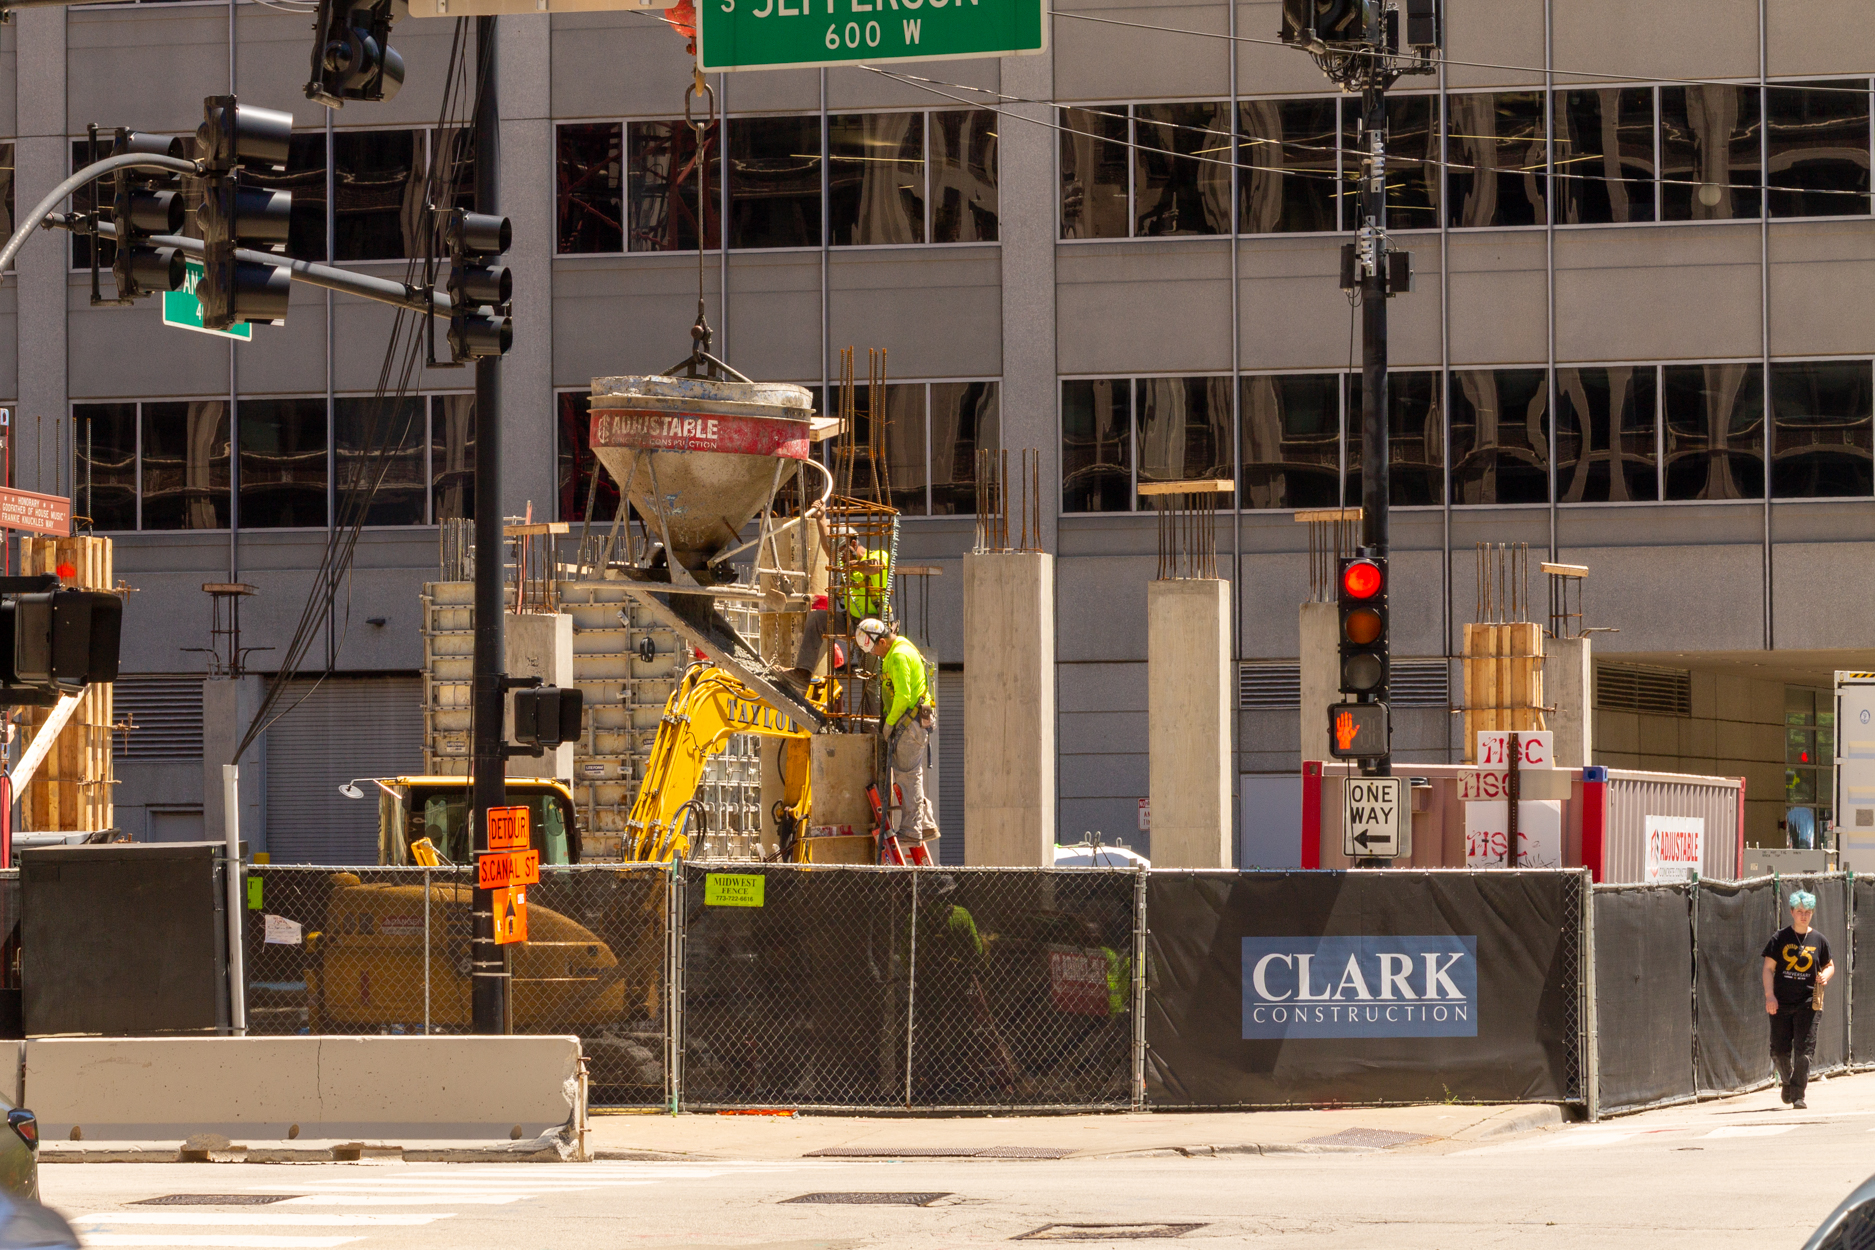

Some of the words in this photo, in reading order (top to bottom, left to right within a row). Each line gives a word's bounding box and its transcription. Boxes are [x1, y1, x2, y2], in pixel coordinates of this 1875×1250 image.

[824, 21, 881, 49] 600
[903, 19, 921, 45] W
[2, 502, 26, 515] GODFATHER
[28, 507, 33, 516] OF
[35, 508, 49, 519] HOUSE
[18, 496, 40, 507] HONORARY
[2, 512, 20, 524] FRANKIE
[22, 515, 44, 527] KNUCKLES
[45, 520, 54, 529] WAY
[1352, 785, 1393, 803] ONE
[1351, 806, 1394, 825] WAY
[491, 816, 527, 840] DETOUR
[1660, 831, 1698, 862] ADJUSTABLE
[525, 856, 535, 877] ST
[714, 877, 757, 887] MIDWEST
[722, 887, 749, 895] FENCE
[1253, 953, 1467, 1001] CLARK
[1253, 1006, 1468, 1023] CONSTRUCTION
